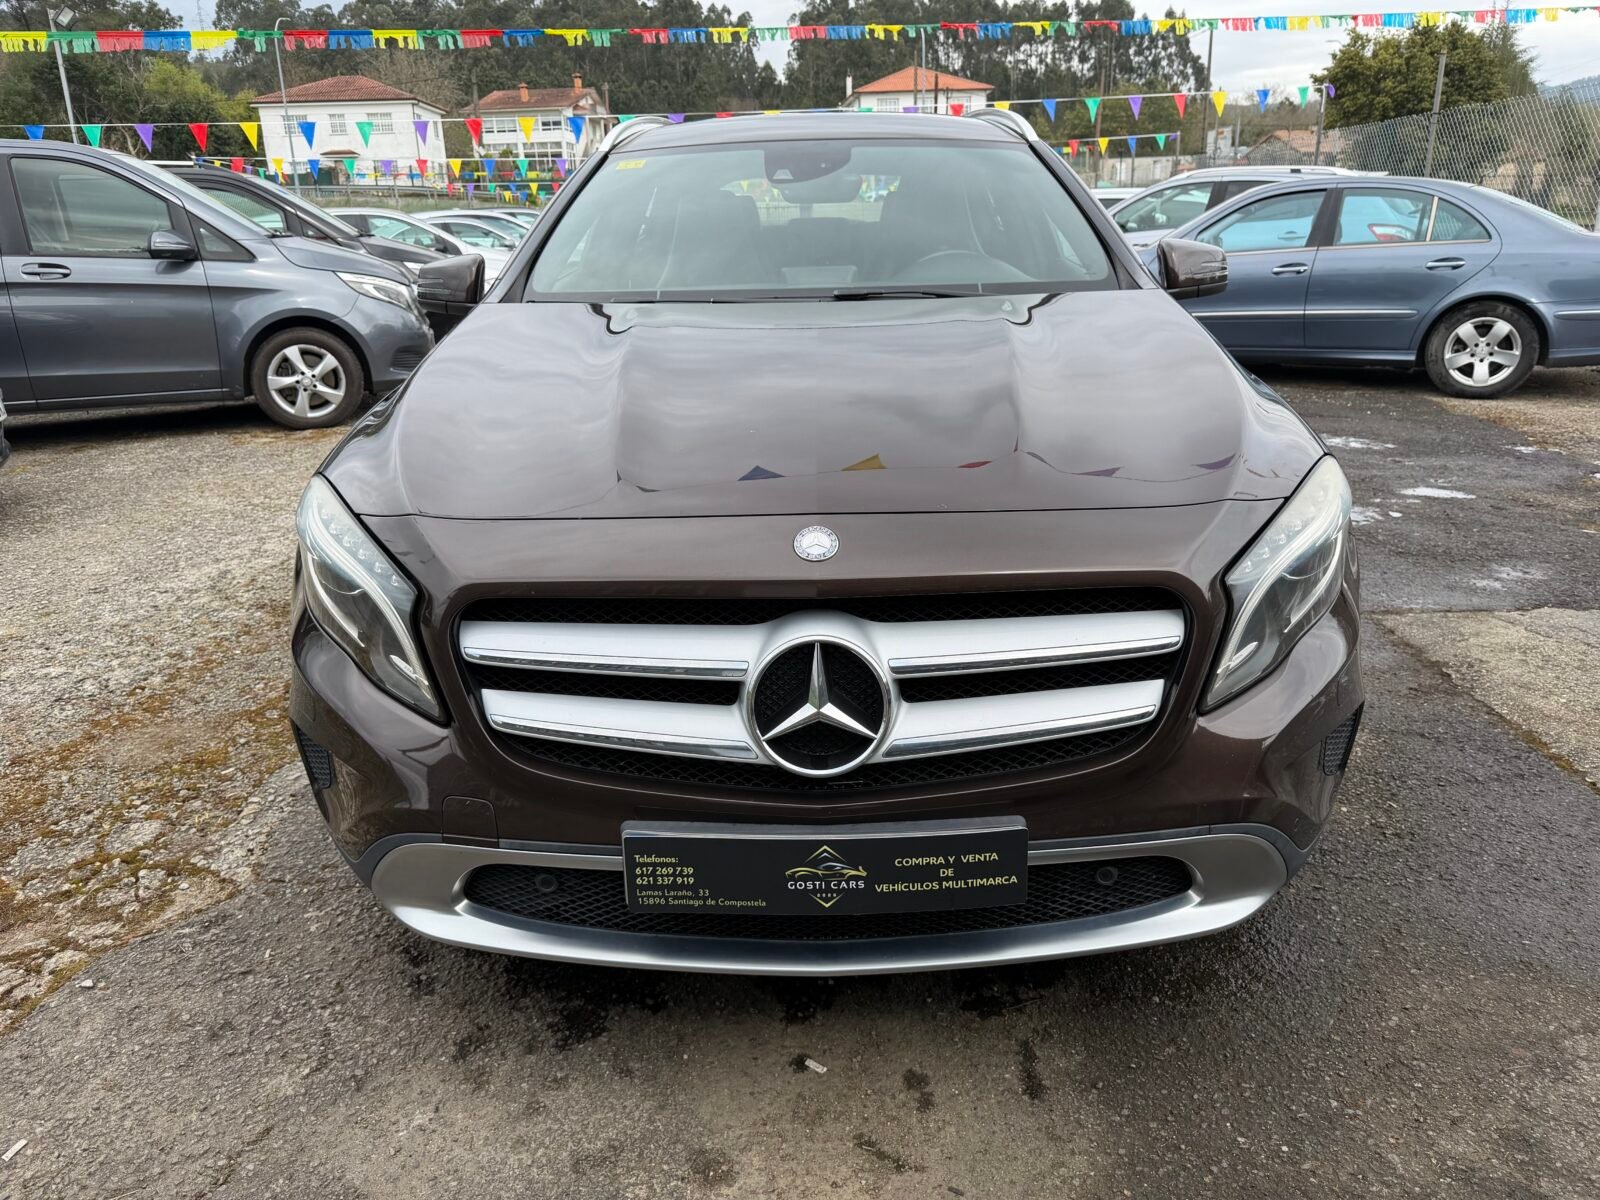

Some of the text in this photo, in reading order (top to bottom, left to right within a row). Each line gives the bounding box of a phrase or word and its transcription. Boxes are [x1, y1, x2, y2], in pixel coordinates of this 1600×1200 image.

[894, 852, 999, 867] COMPRA Y VENTA
[635, 866, 694, 875] 617 269 739
[940, 868, 955, 877] DE
[636, 876, 695, 885] 621 337 919
[787, 880, 865, 890] GOSTI CARS
[874, 875, 1018, 893] VEHÍCULOS MULTIMARCA
[636, 888, 663, 896] Lamas
[698, 888, 710, 896] 33
[638, 897, 767, 908] 15896 Santiago de Compostela
